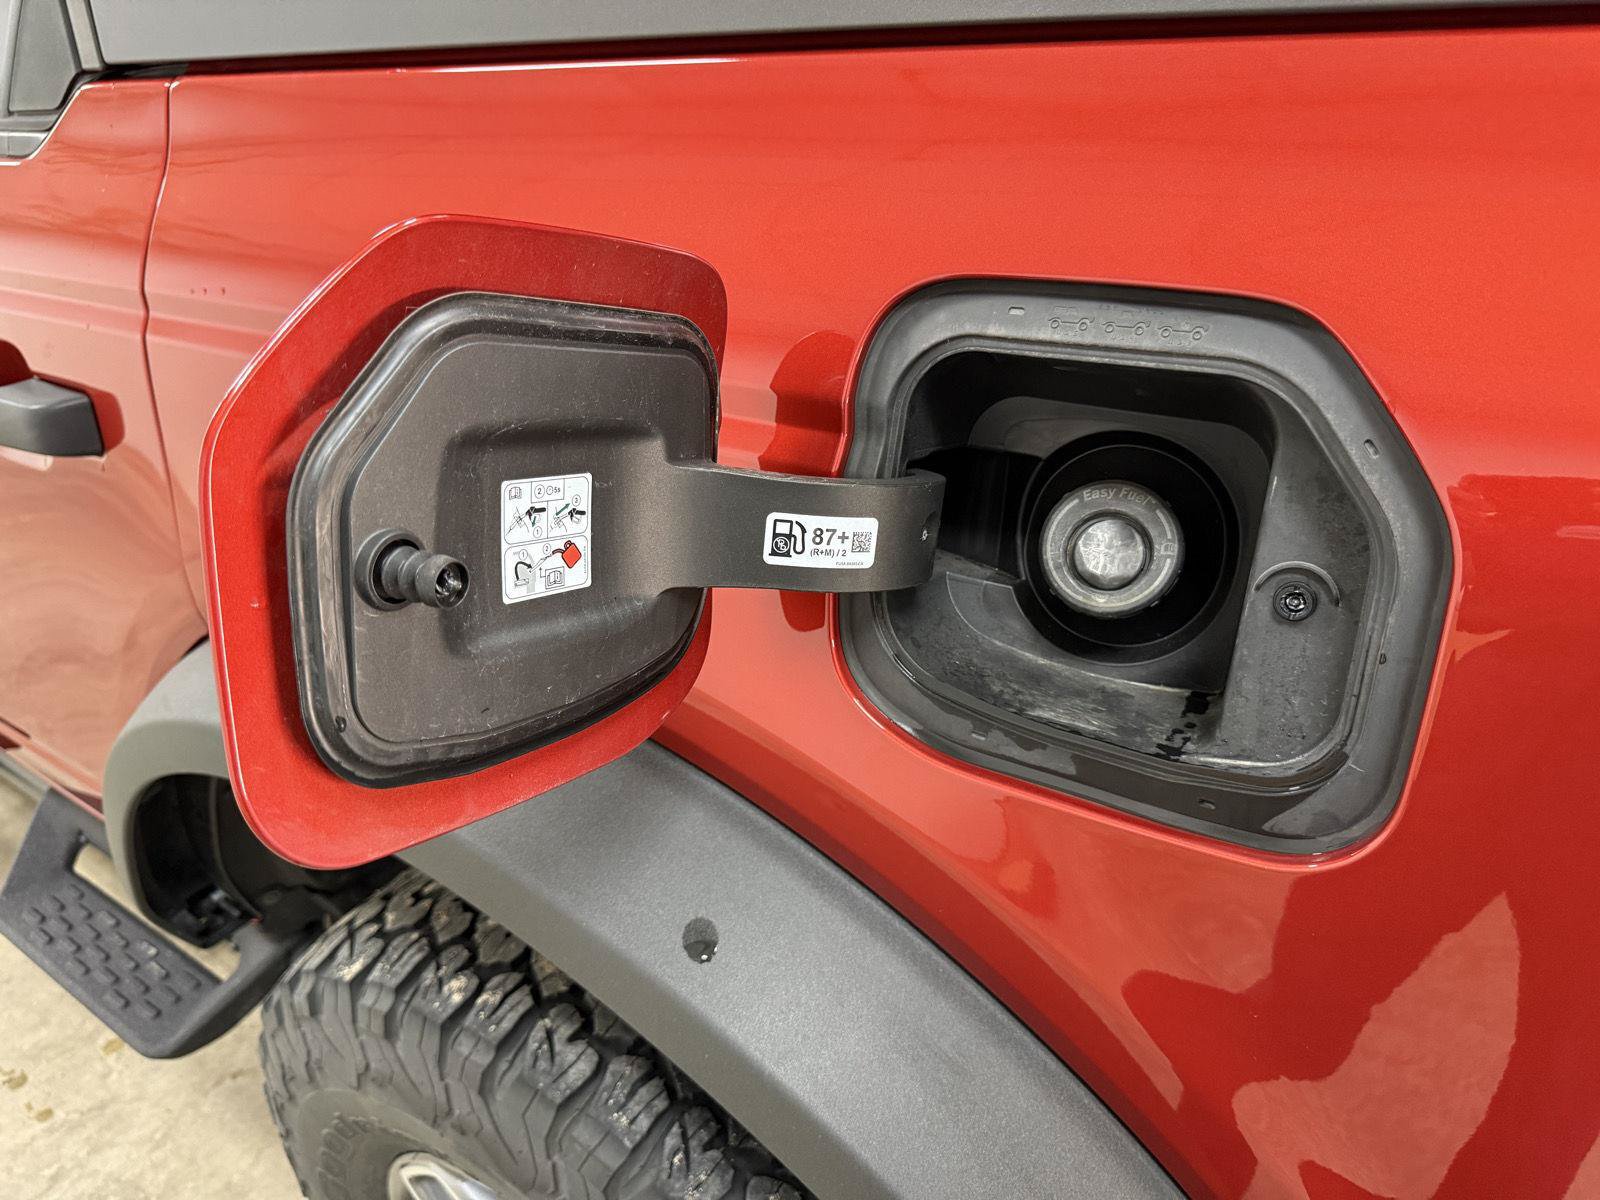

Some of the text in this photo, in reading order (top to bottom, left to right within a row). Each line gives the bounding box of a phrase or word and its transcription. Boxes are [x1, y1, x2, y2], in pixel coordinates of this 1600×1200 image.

[1083, 487, 1152, 506] Easy Fuel
[811, 527, 850, 546] 87+
[810, 548, 835, 558] (R+M)
[841, 549, 847, 557] 2
